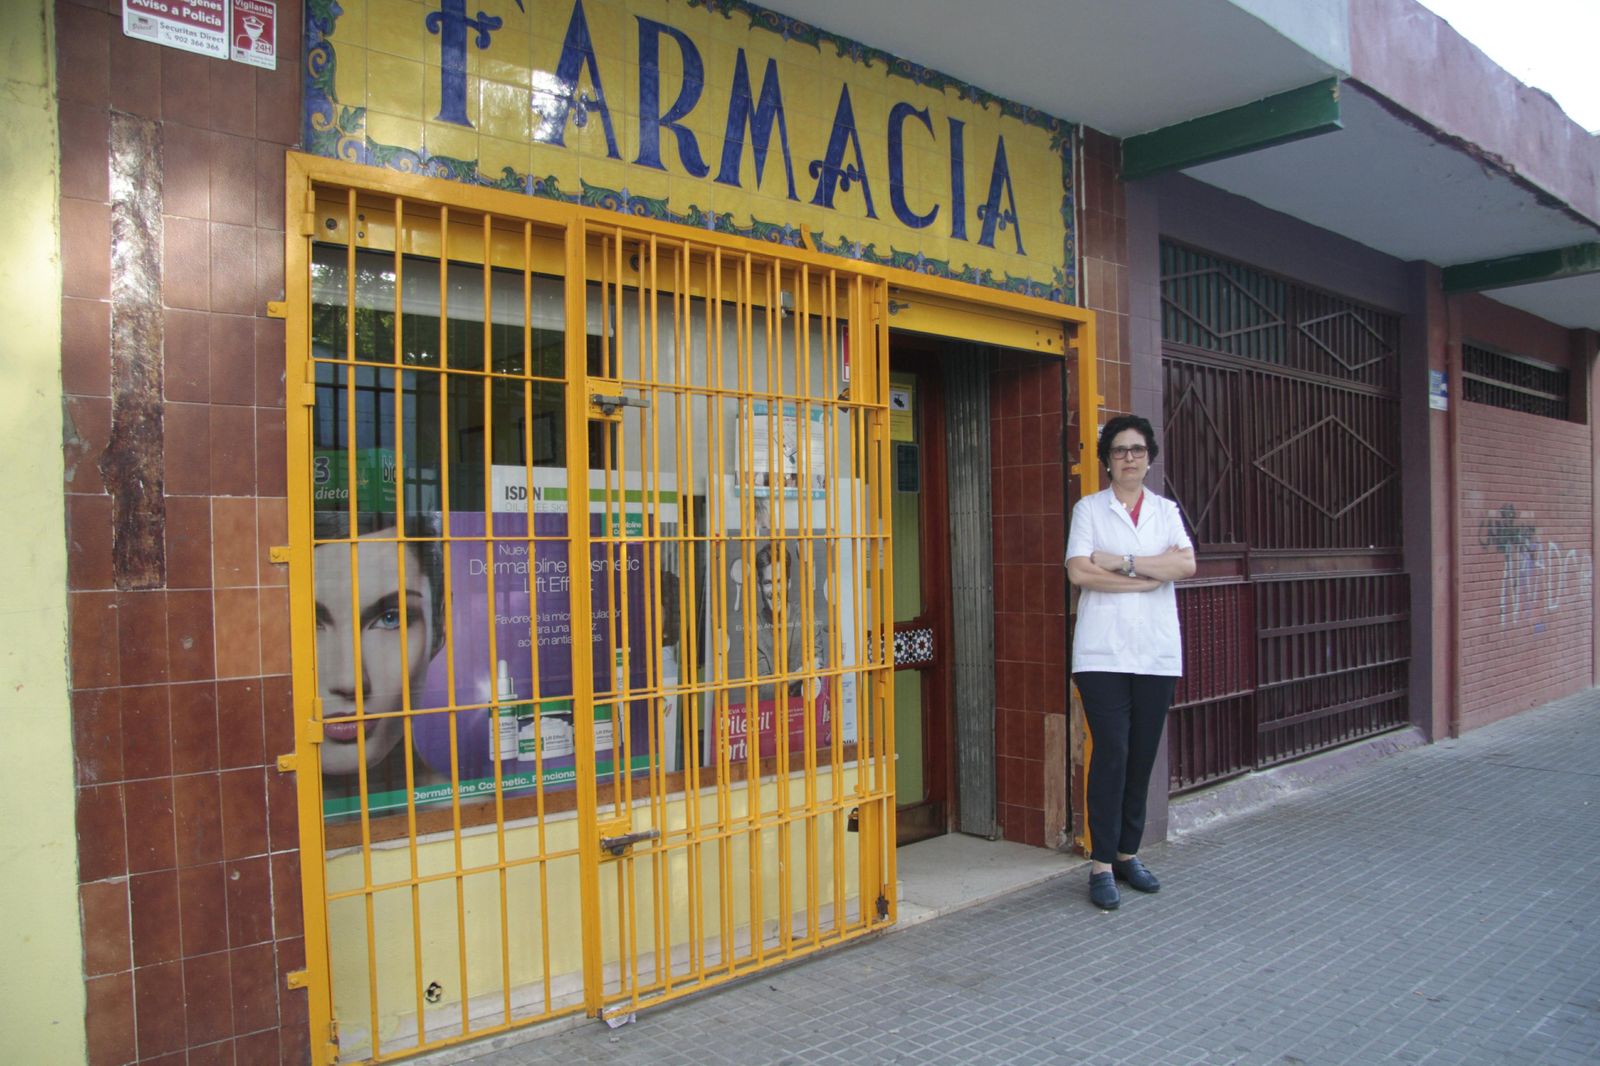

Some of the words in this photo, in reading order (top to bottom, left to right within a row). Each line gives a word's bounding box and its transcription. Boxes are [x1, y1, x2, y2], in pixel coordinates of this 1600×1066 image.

[171, 7, 179, 16] a
[160, 21, 197, 37] Securitas
[200, 31, 224, 44] Direct
[425, 0, 1027, 256] FARMACIA
[505, 486, 541, 500] ISDN
